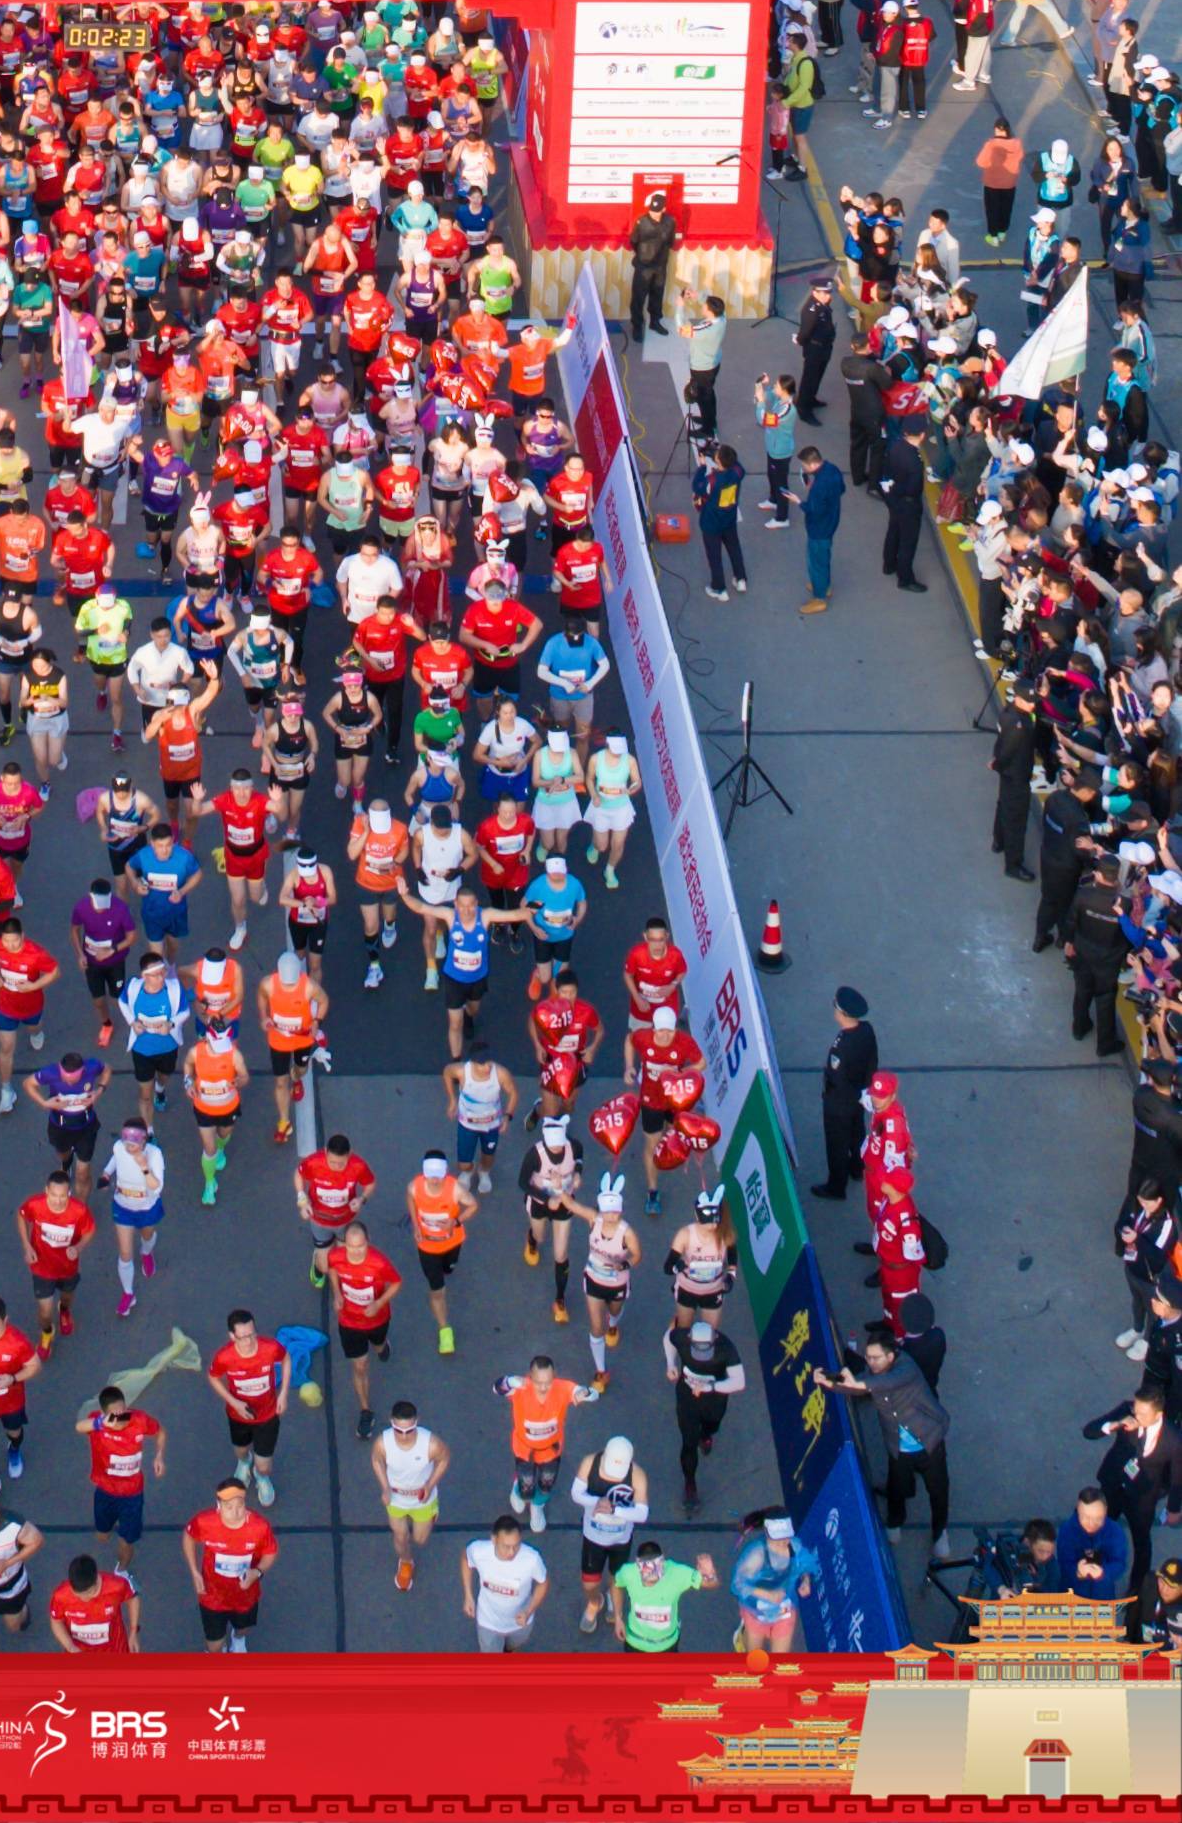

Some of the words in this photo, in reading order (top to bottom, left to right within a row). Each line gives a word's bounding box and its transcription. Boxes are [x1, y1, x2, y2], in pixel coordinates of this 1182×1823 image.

[69, 28, 146, 47] 0:02:23
[549, 1009, 573, 1028] 2:15
[714, 967, 748, 1078] BRS
[662, 1079, 696, 1096] 2:15
[593, 1112, 624, 1133] 2:15
